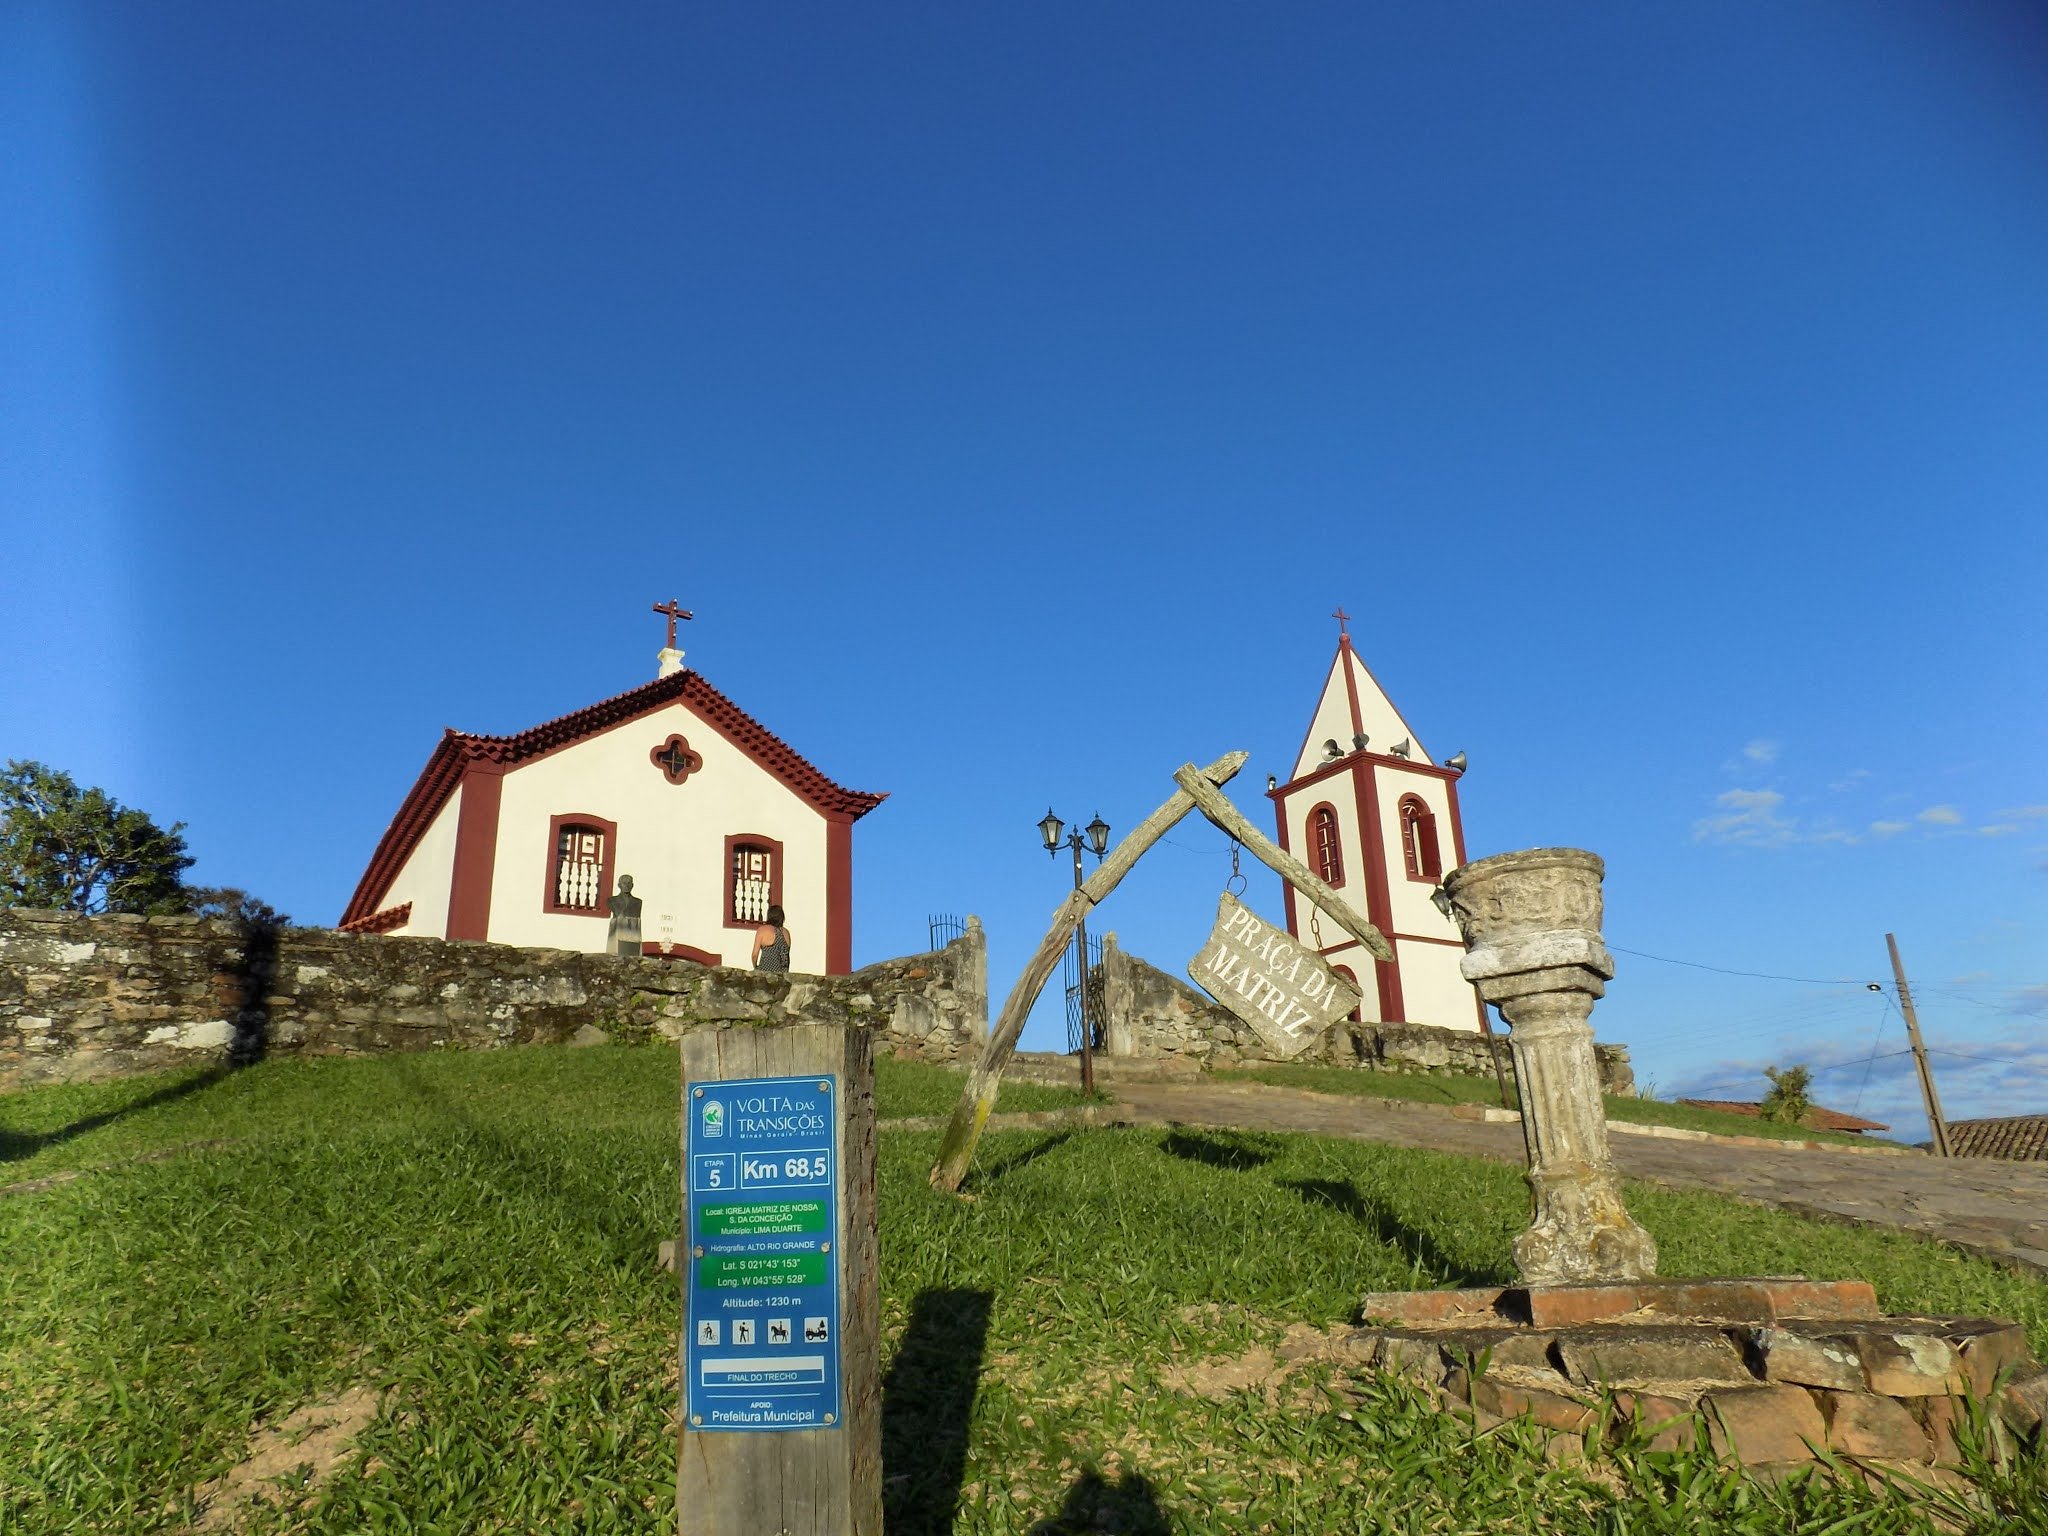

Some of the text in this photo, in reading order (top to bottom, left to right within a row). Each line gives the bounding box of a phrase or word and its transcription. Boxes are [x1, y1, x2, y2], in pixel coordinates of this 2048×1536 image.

[1222, 905, 1337, 1011] PRAÇA DA
[737, 1097, 815, 1113] VOLTA DAS
[737, 1114, 824, 1132] TRANSIÇÕES
[744, 1158, 826, 1179] Km 68,5
[709, 1170, 720, 1187] 5
[725, 1207, 750, 1215] IGREJA
[752, 1206, 777, 1214] MATRIZ
[792, 1204, 818, 1212] NOSSA
[749, 1214, 793, 1223] CONCEIÇÃO
[721, 1227, 751, 1235] Município:
[772, 1225, 802, 1233] DUARTE
[711, 1245, 746, 1253] Hidrografia:
[747, 1243, 765, 1251] ALTO
[783, 1241, 815, 1249] GRANDE
[723, 1262, 737, 1270] Lat.
[740, 1261, 745, 1269] S
[718, 1278, 739, 1288] Long.
[742, 1277, 751, 1285] W
[723, 1298, 763, 1308] Altitude:
[765, 1297, 789, 1306] 1230
[764, 1372, 797, 1381] TRECHO
[712, 1409, 814, 1422] Prefeitura Municipal
